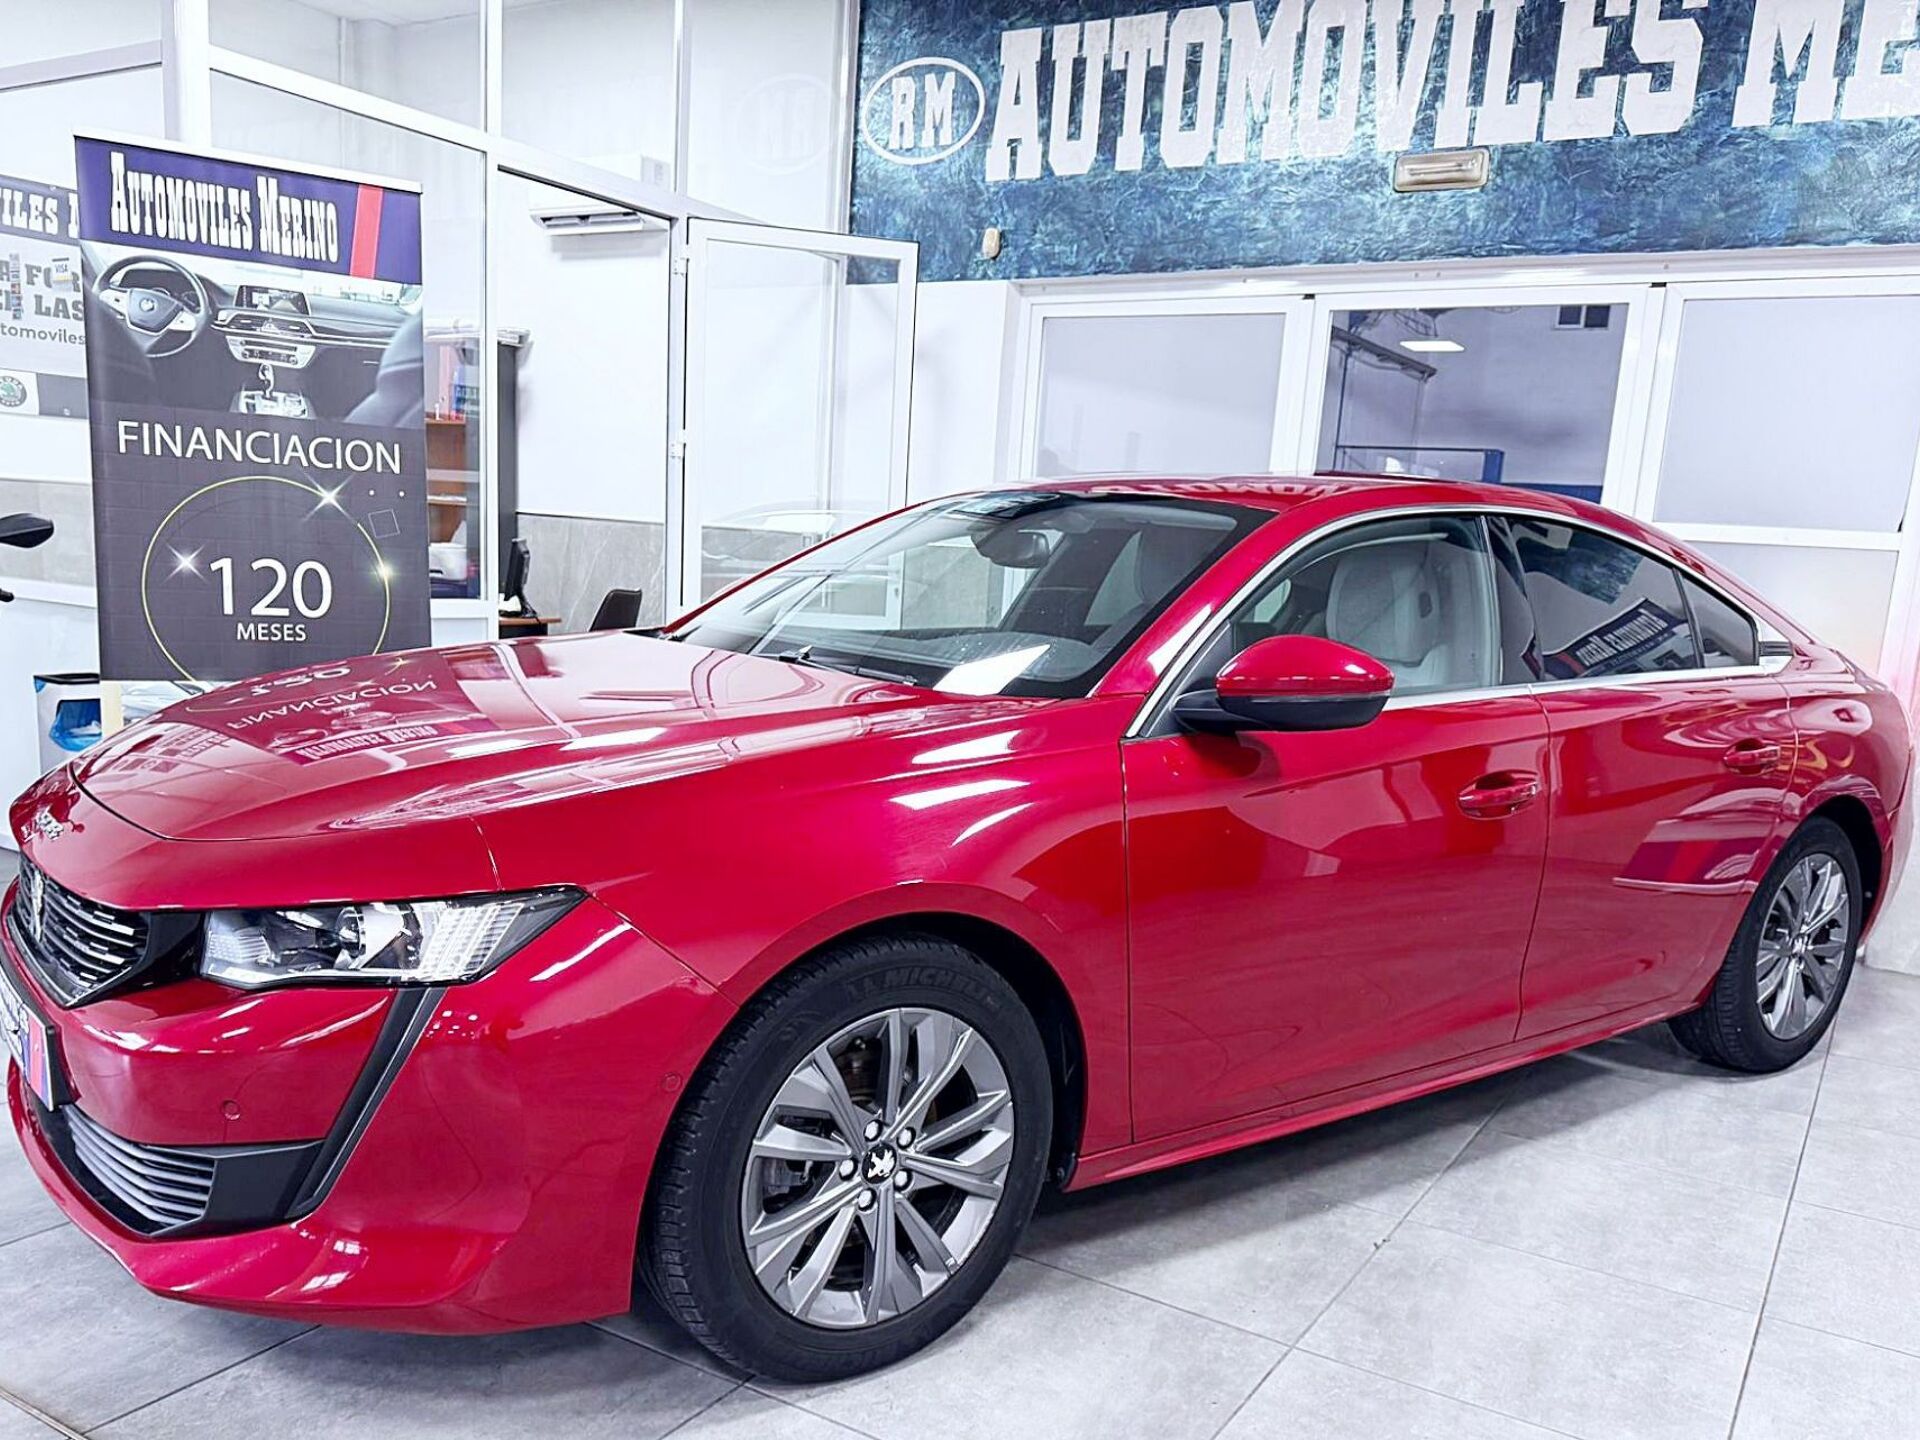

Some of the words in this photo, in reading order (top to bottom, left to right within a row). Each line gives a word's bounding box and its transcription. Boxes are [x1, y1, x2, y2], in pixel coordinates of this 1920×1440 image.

[888, 71, 957, 150] RM
[985, 0, 1703, 182] AUTOMOVILES
[109, 150, 254, 252] AUTOMOVILES
[256, 175, 340, 264] MERINO
[34, 294, 84, 322] LAS
[117, 420, 401, 475] FINANCIACION
[209, 556, 333, 619] 120
[236, 622, 307, 642] MESES
